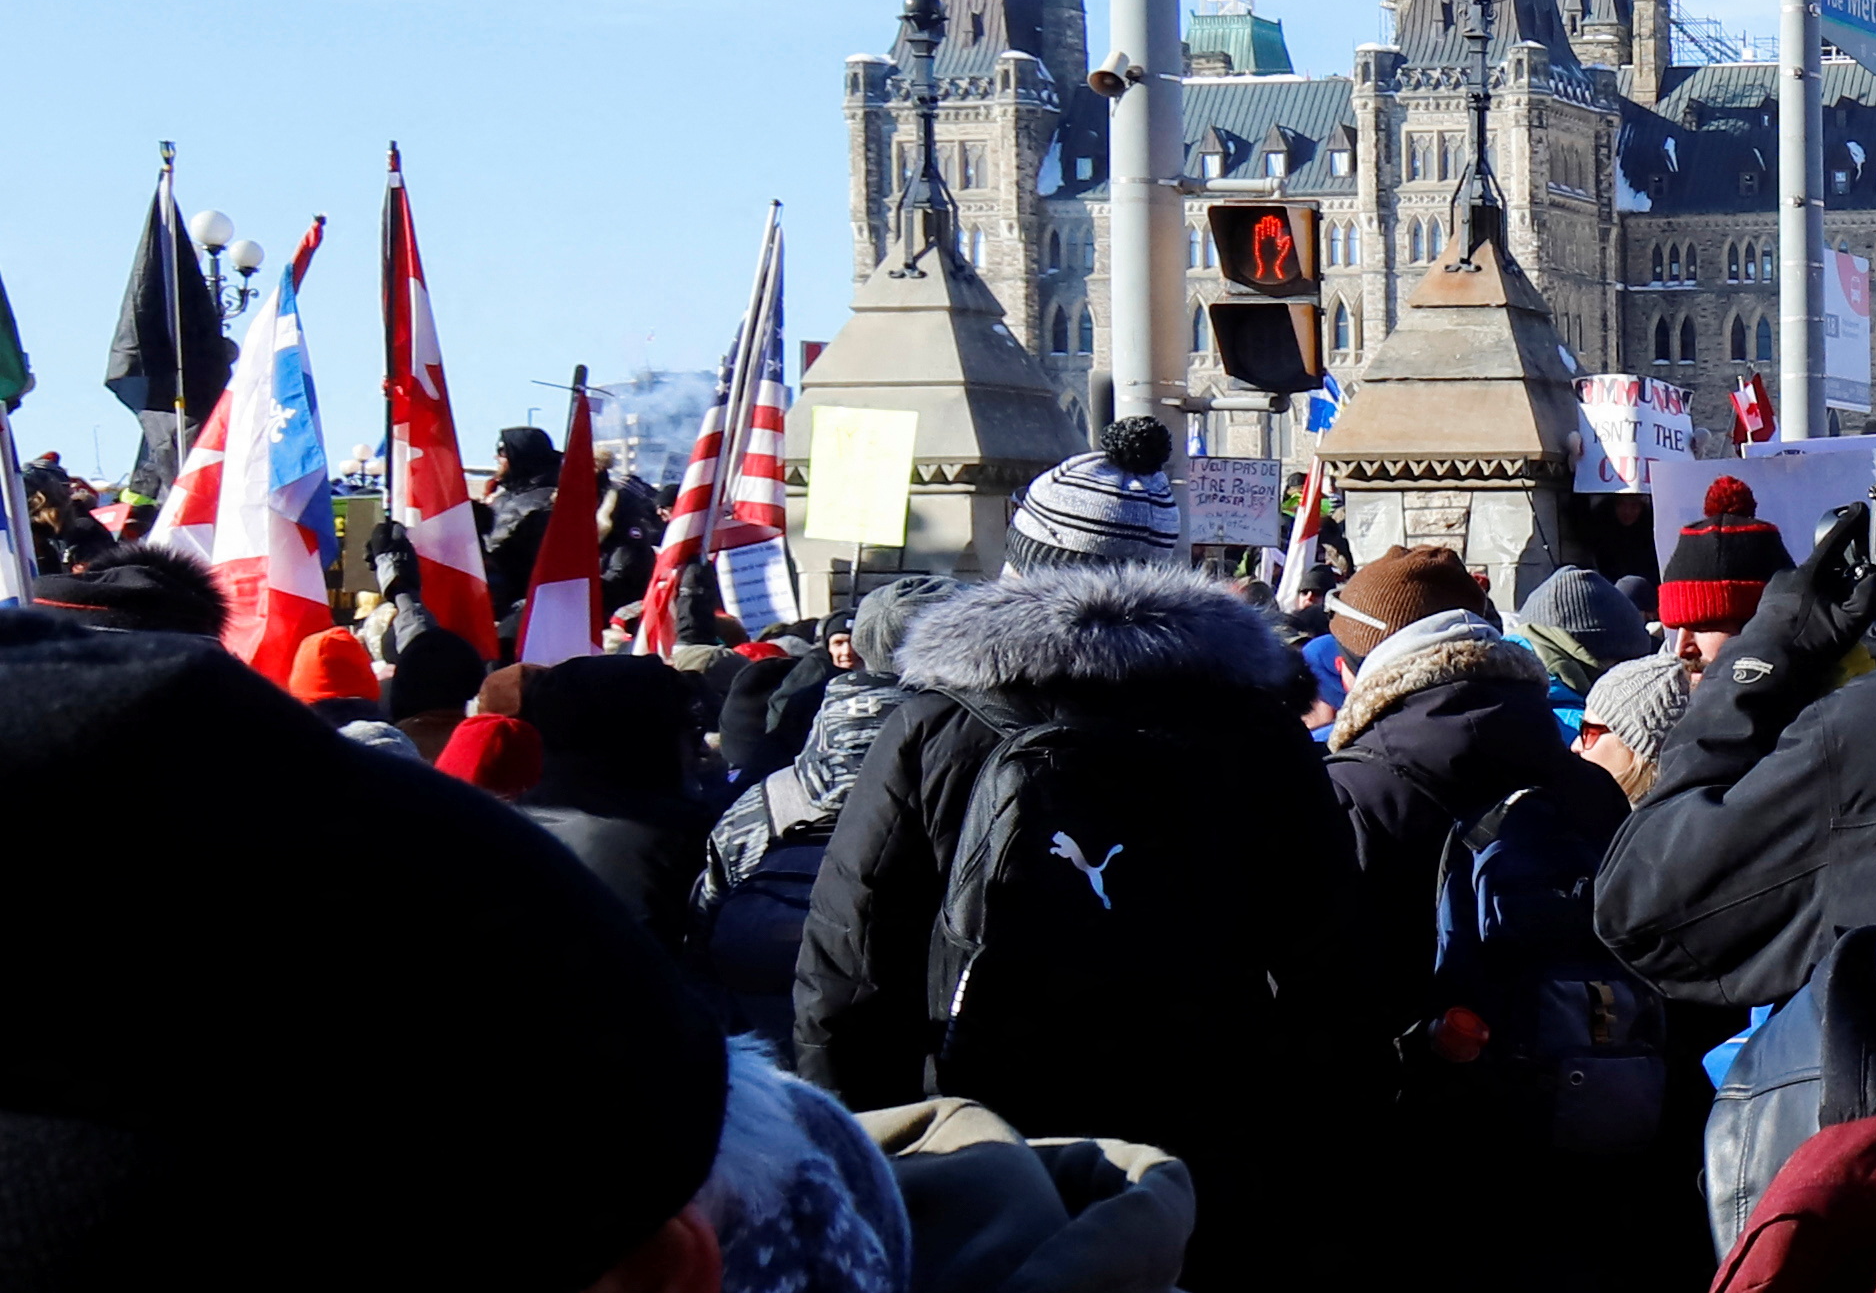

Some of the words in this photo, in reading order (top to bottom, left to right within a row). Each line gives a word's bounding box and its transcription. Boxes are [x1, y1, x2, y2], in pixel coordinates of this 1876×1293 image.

[1593, 417, 1642, 444] ISN'T
[1653, 422, 1685, 453] THE
[1232, 461, 1258, 475] PAS
[1261, 463, 1277, 477] DE
